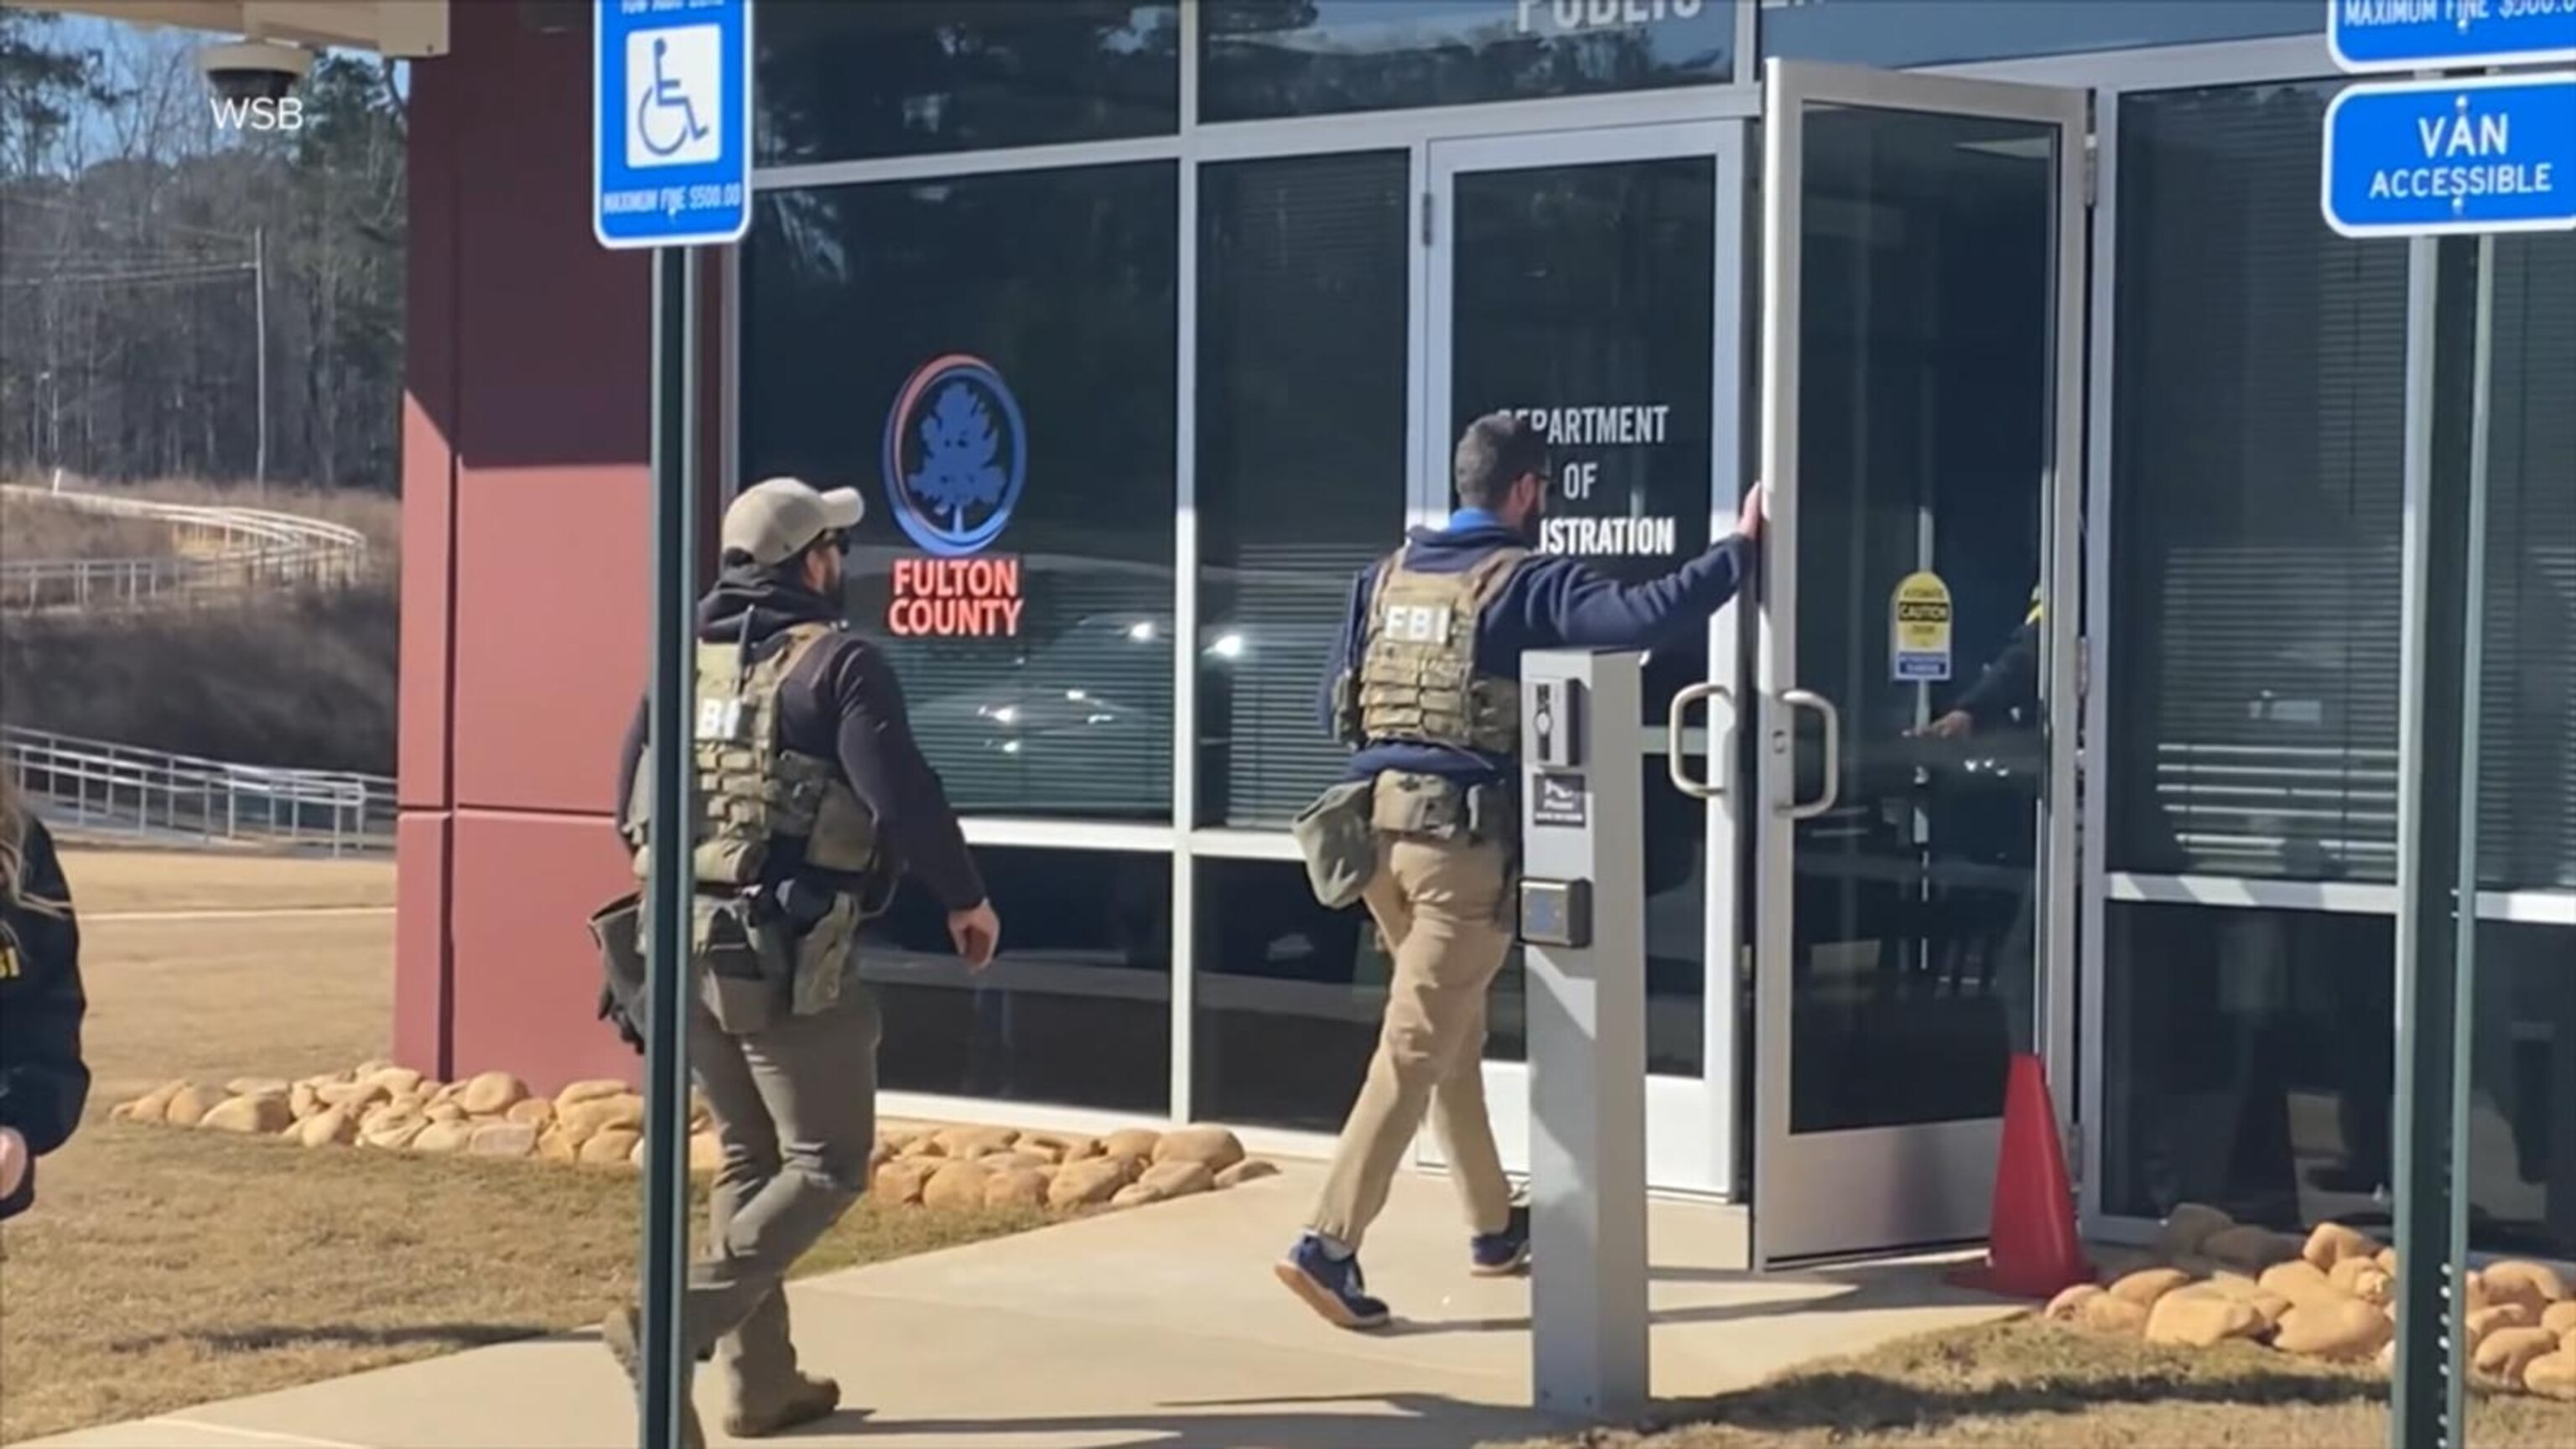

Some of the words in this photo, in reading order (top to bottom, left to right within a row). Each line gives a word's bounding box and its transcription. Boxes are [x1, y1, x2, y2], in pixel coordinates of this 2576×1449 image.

[2418, 112, 2508, 159] VAN
[2369, 163, 2553, 200] ACCESSIBLE
[1497, 406, 1670, 444] PARTMENT
[1562, 462, 1598, 500] OF
[1539, 516, 1675, 555] ISTRATION
[893, 558, 1019, 598] FULTON
[888, 598, 1025, 637] COUNTY
[1385, 605, 1451, 643] FBI
[696, 698, 741, 740] BI
